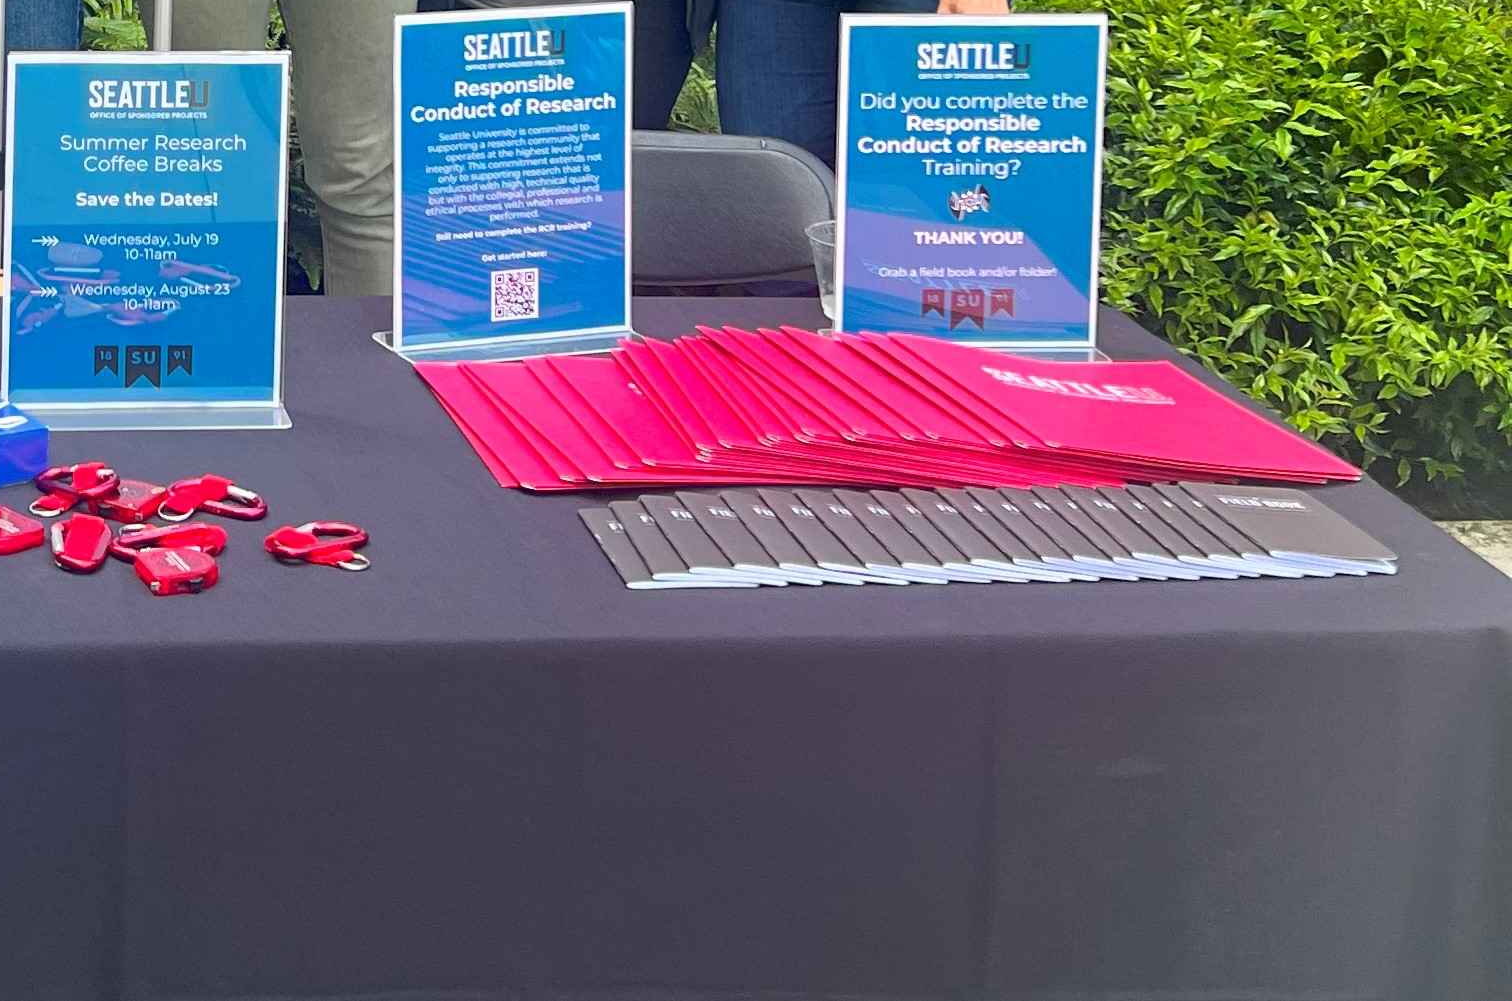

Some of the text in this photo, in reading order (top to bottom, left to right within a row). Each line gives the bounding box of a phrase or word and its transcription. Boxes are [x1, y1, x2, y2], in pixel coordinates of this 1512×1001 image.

[455, 74, 575, 99] Responsible
[410, 93, 616, 123] Conduct of Research
[860, 92, 1088, 113] Did you complete the
[906, 114, 1041, 134] Responsible
[60, 134, 246, 150] Summer Research
[857, 136, 1087, 153] Conduct of Research
[84, 155, 223, 172] Coffee Breaks
[922, 159, 1021, 179] Training?
[76, 191, 218, 206] Save the Dates!
[84, 233, 219, 248] Wednesday, July 19
[914, 232, 1024, 244] THANK YOU!
[125, 248, 177, 260] 10-11am
[70, 283, 230, 297] Wednesday, August 23
[124, 299, 176, 310] 10-11am
[956, 295, 979, 306] SU
[132, 351, 156, 364] SU
